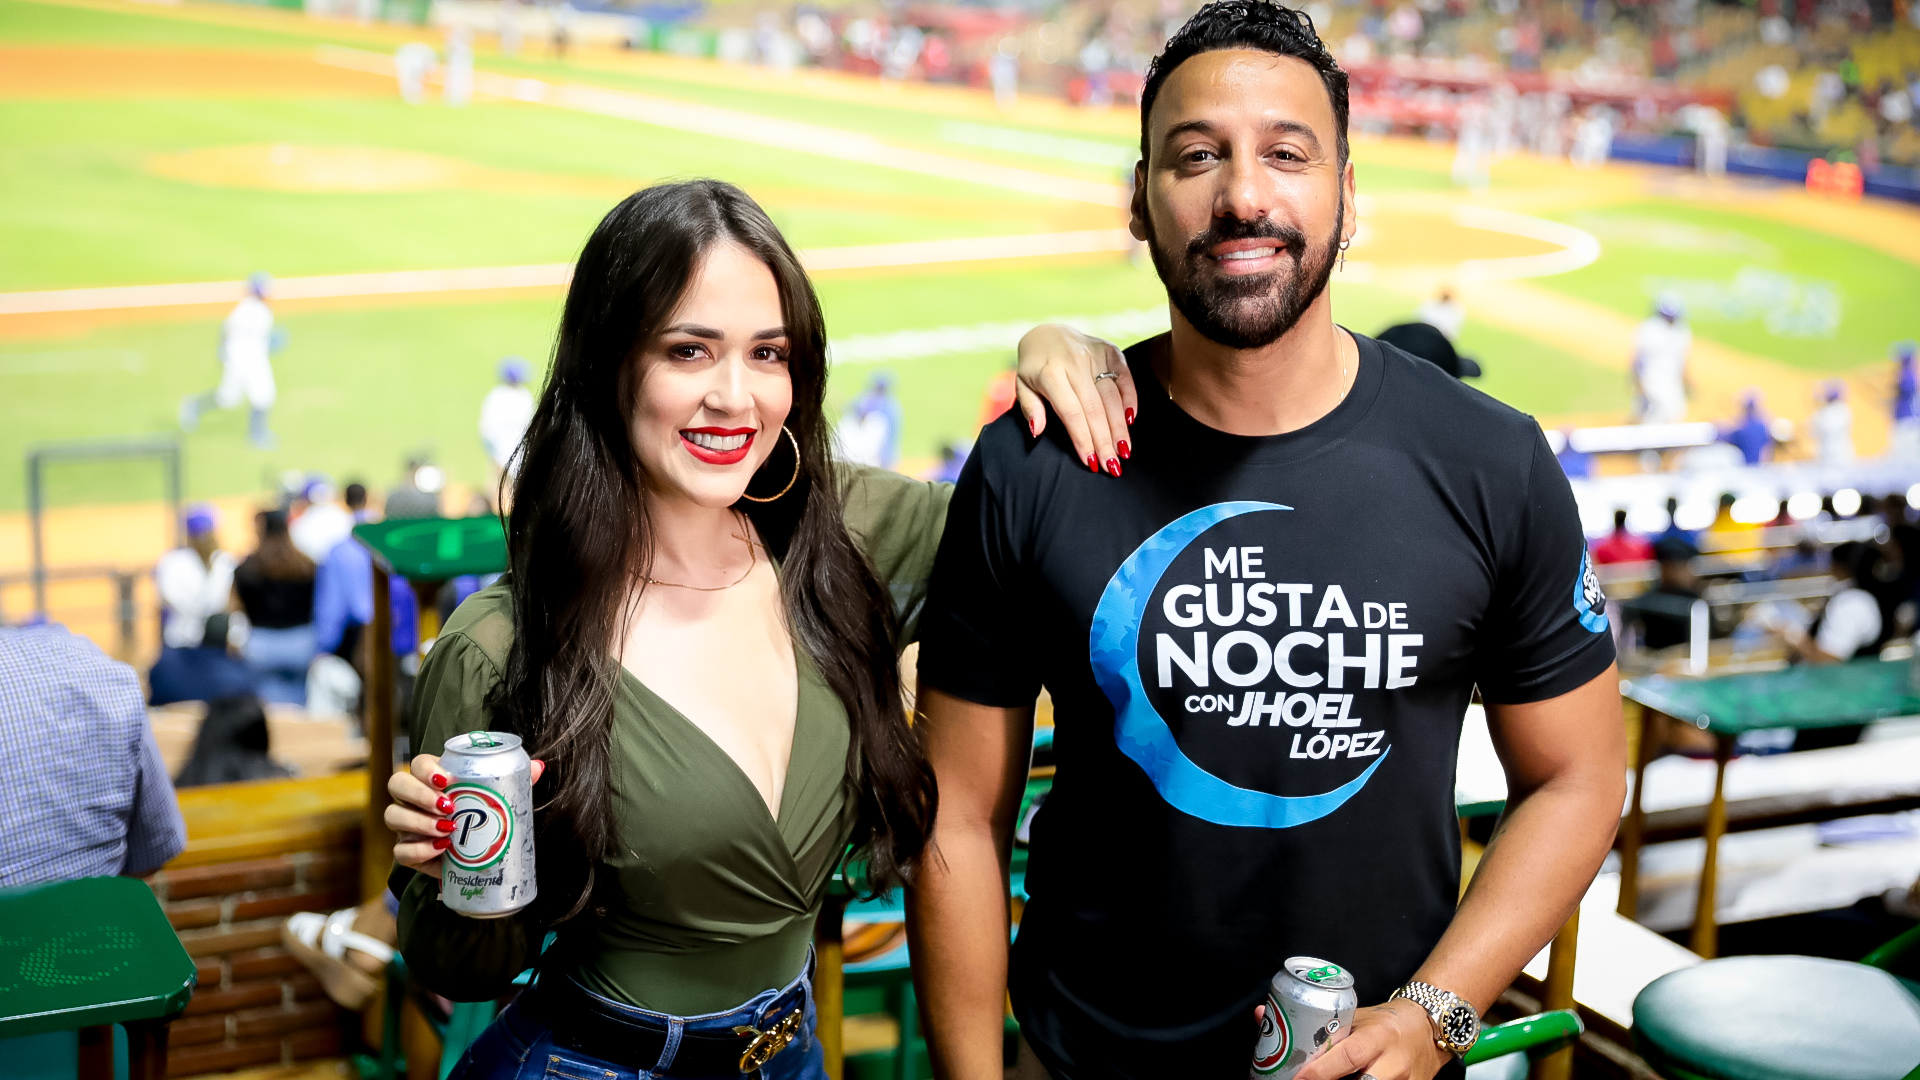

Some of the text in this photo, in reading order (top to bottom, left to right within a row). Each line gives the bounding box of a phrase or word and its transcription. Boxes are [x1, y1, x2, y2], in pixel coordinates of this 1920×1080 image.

[1204, 546, 1266, 579] ME
[1163, 583, 1409, 629] GUSTA DE
[1156, 631, 1423, 689] NOCHE
[1184, 691, 1361, 727] CON JHOEL
[1289, 728, 1385, 759] LÓPEZ
[451, 808, 489, 847] P
[447, 870, 503, 886] Presidente
[460, 886, 485, 900] light
